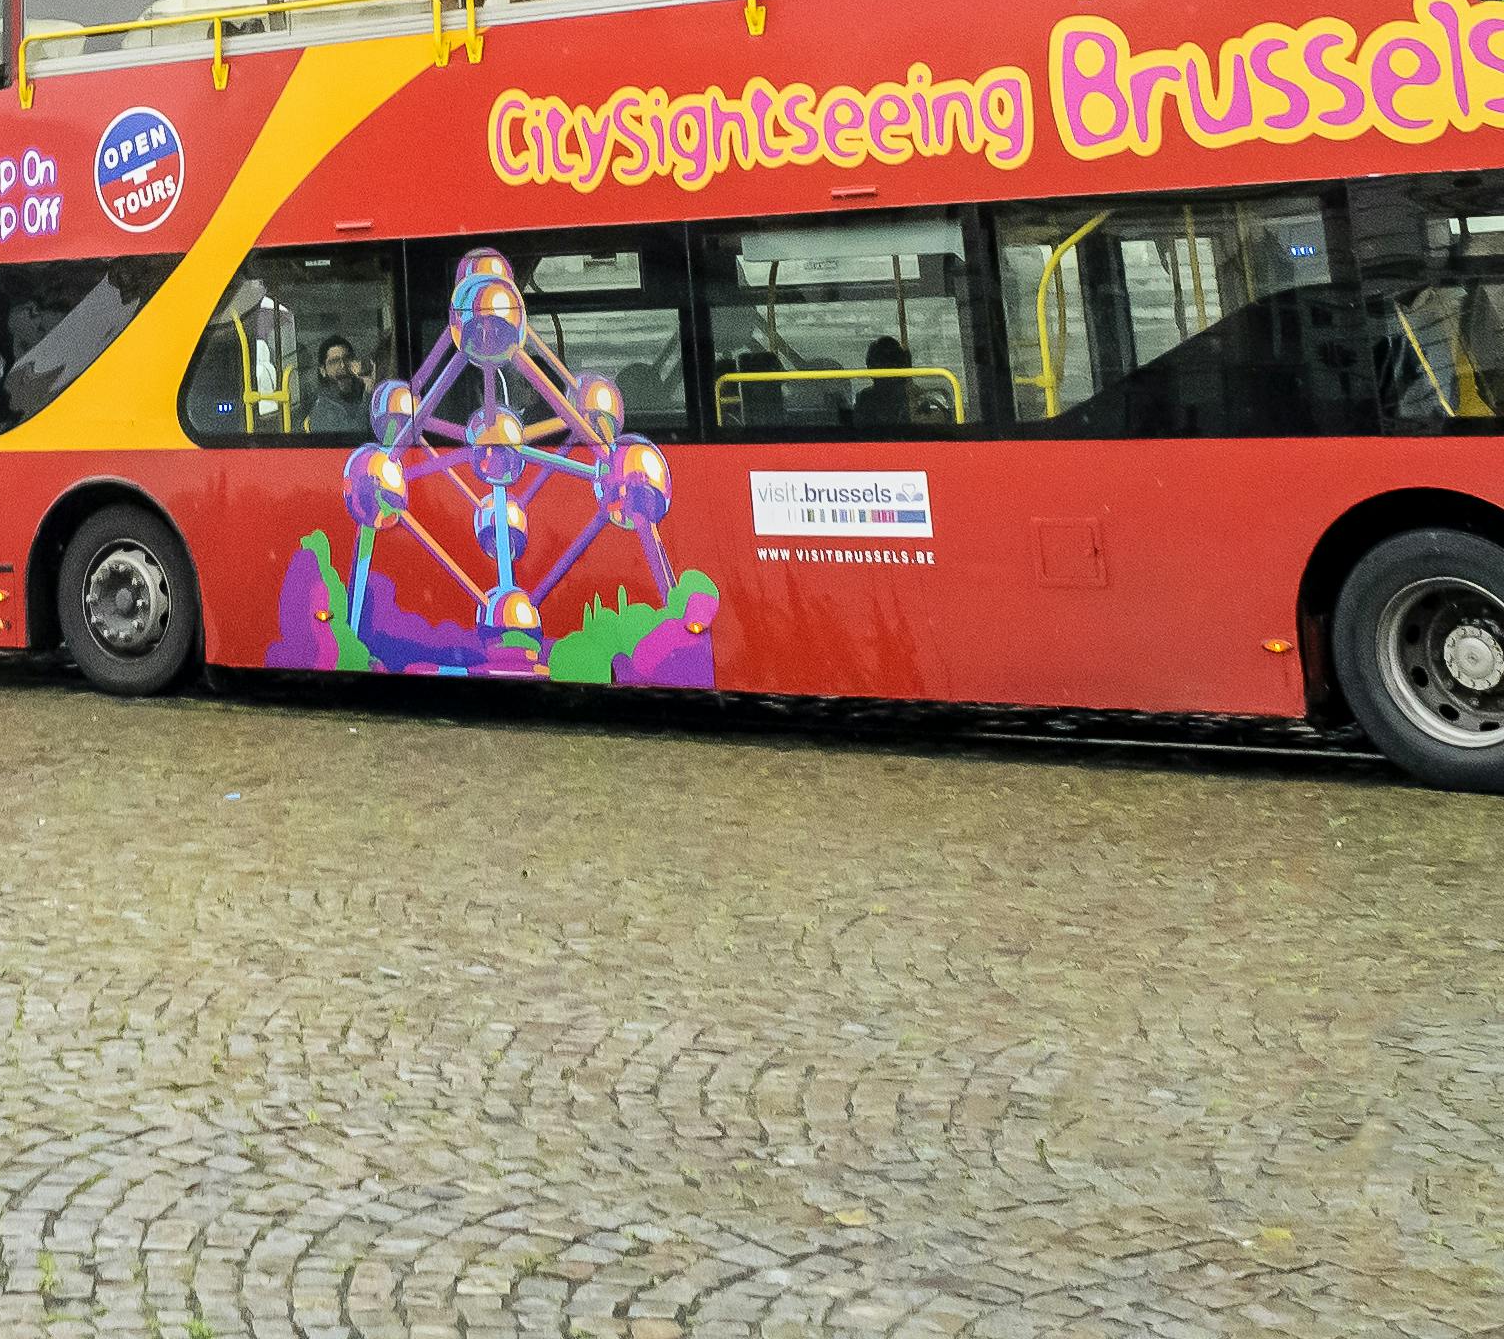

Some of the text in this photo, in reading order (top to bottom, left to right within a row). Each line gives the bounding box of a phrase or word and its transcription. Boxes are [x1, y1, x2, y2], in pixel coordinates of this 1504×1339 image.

[103, 124, 167, 170] OPEN
[21, 149, 56, 188] On
[22, 196, 62, 234] Off
[113, 174, 177, 219] TOURS
[756, 546, 936, 565] WWWVISITBRUSSELS.BE
